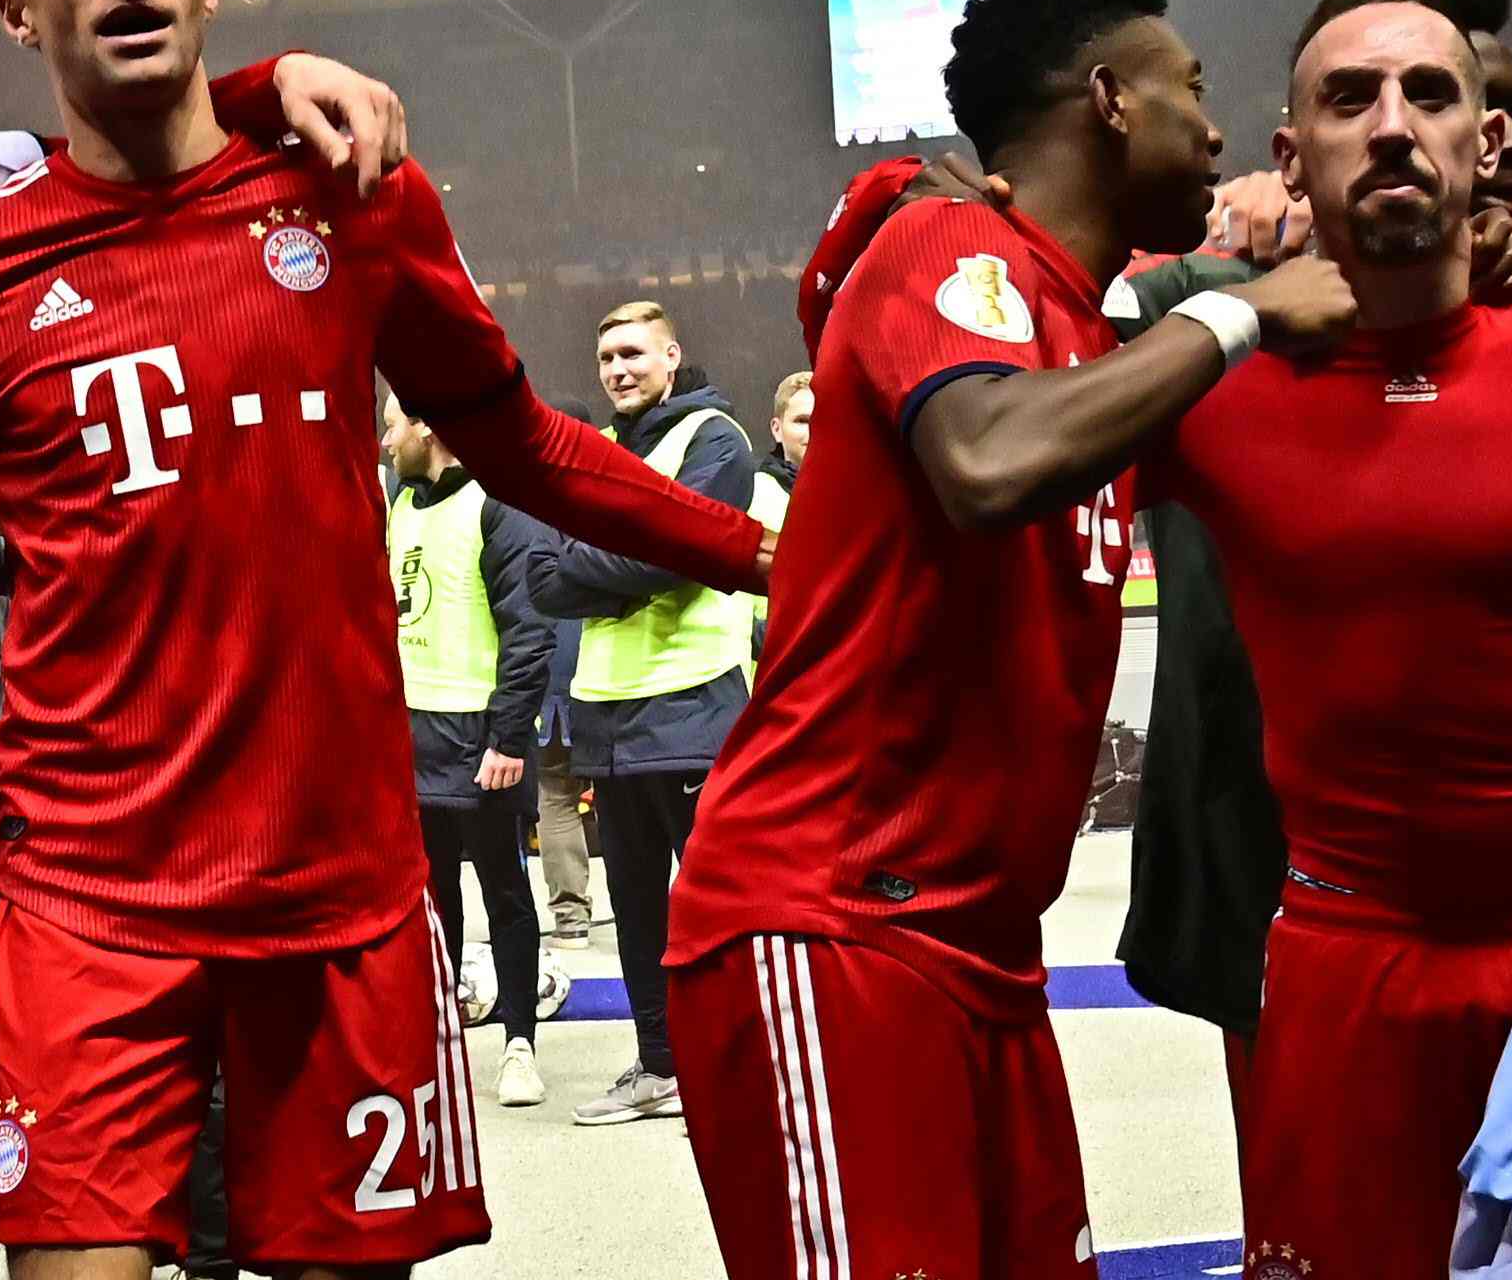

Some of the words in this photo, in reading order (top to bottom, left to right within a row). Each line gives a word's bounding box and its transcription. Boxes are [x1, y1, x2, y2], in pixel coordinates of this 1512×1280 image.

[30, 298, 94, 331] adidas
[400, 635, 429, 648] OKAL
[346, 1080, 438, 1212] 25
